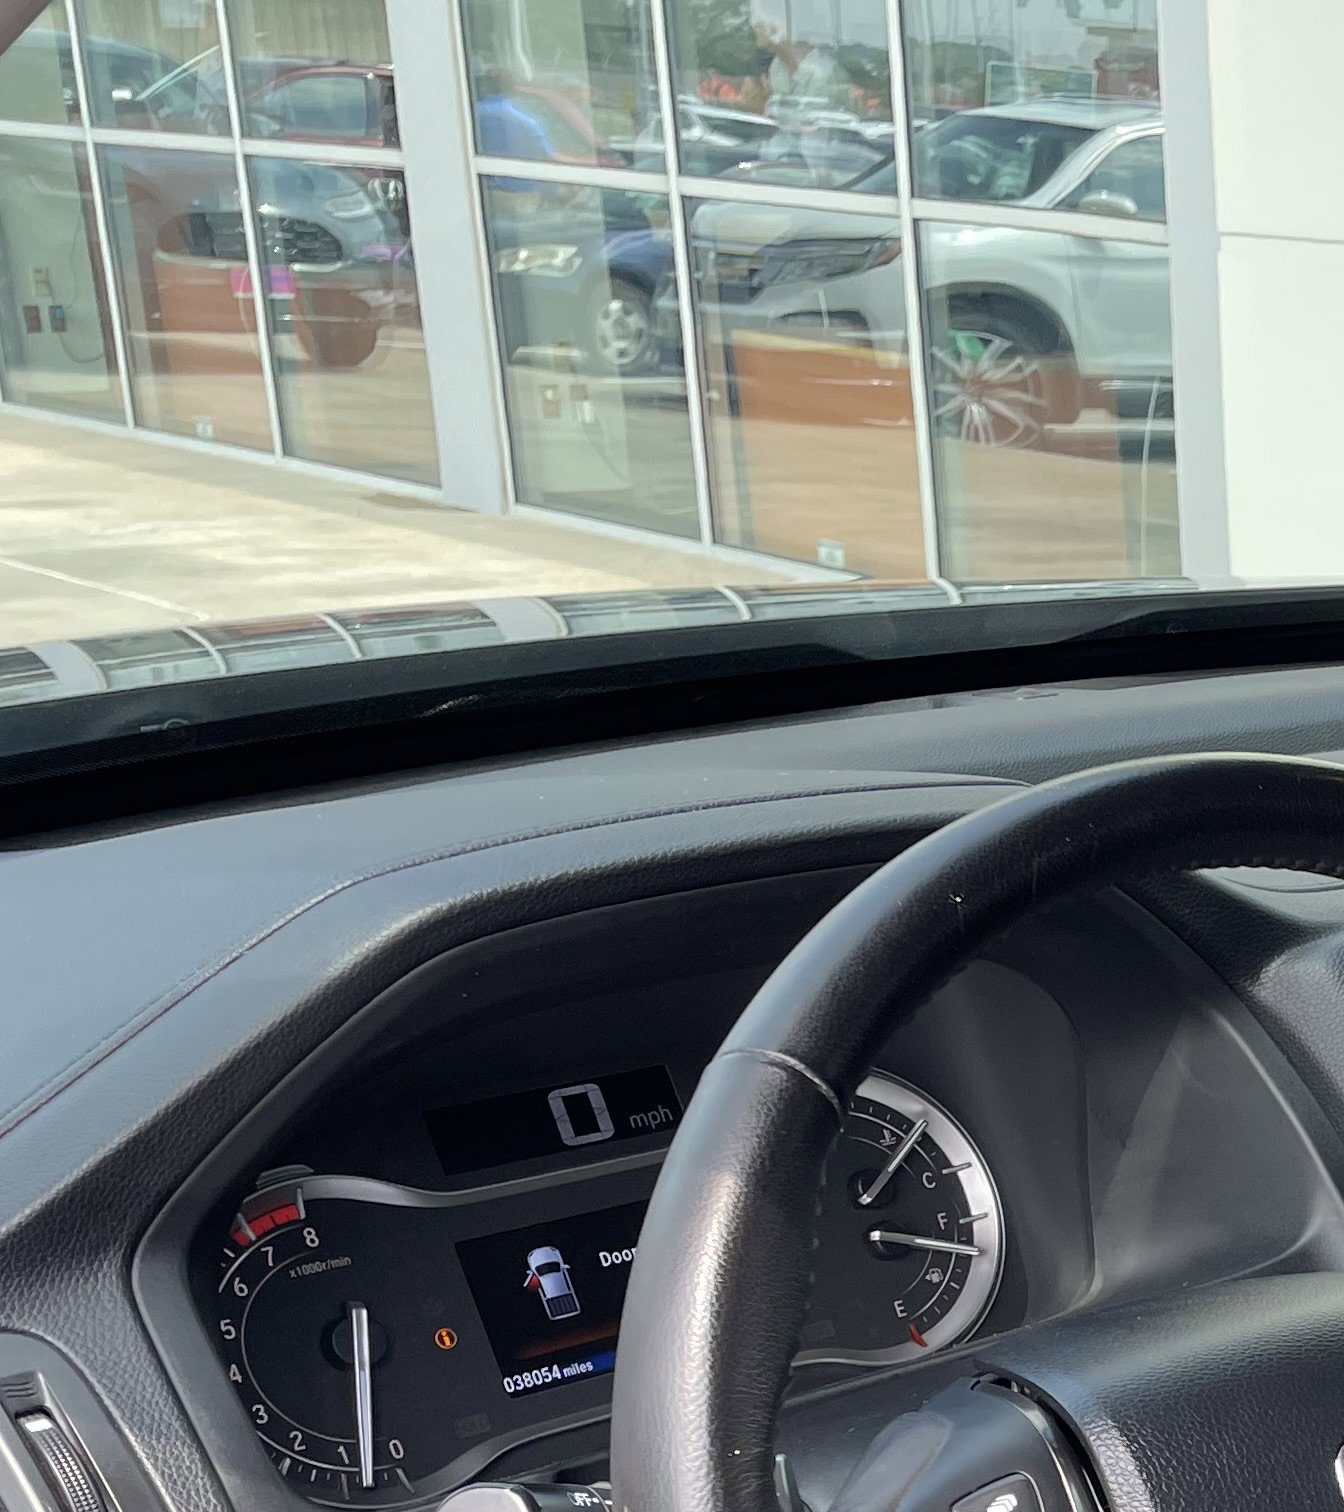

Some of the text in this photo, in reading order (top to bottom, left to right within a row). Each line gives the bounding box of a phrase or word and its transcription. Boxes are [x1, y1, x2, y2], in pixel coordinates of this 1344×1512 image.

[547, 1083, 674, 1146] 0 mph
[922, 1172, 936, 1189] C
[937, 1212, 948, 1230] F
[302, 1227, 320, 1248] 8
[260, 1246, 274, 1267] 7
[233, 1277, 249, 1297] 6
[894, 1300, 908, 1319] E
[220, 1319, 236, 1340] 5
[229, 1364, 243, 1384] 4
[503, 1360, 594, 1393] 038054 miles
[252, 1404, 269, 1424] 3
[289, 1431, 306, 1451] 2
[388, 1438, 404, 1459] 0
[337, 1445, 349, 1465] 1
